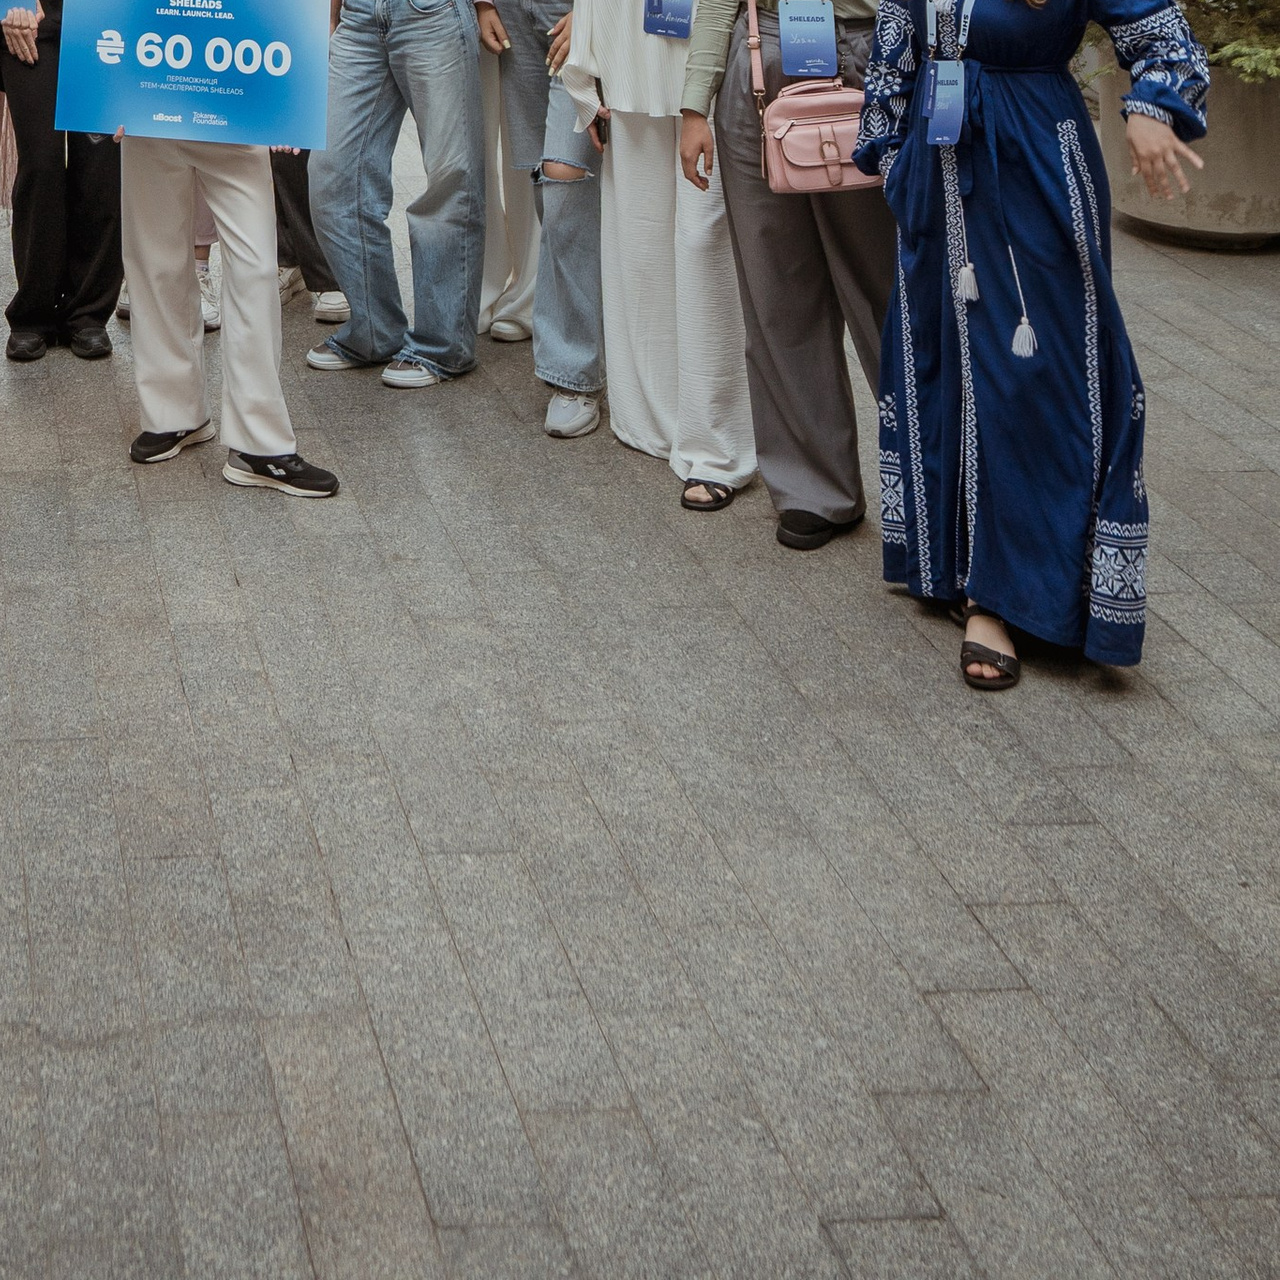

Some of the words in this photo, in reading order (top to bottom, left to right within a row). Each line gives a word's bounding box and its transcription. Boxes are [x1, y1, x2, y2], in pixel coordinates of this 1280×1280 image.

[156, 8, 181, 16] LEARN.
[182, 10, 214, 18] LAUNCH.
[214, 12, 235, 20] LEAD.
[136, 32, 193, 70] 60
[204, 36, 292, 77] 000
[166, 74, 218, 85] ПЕРЕМОЖНИЦЯ
[210, 87, 244, 96] SHELEADS
[153, 112, 182, 122] uBoost
[192, 112, 218, 120] Tokarev
[192, 117, 228, 126] Foundation
